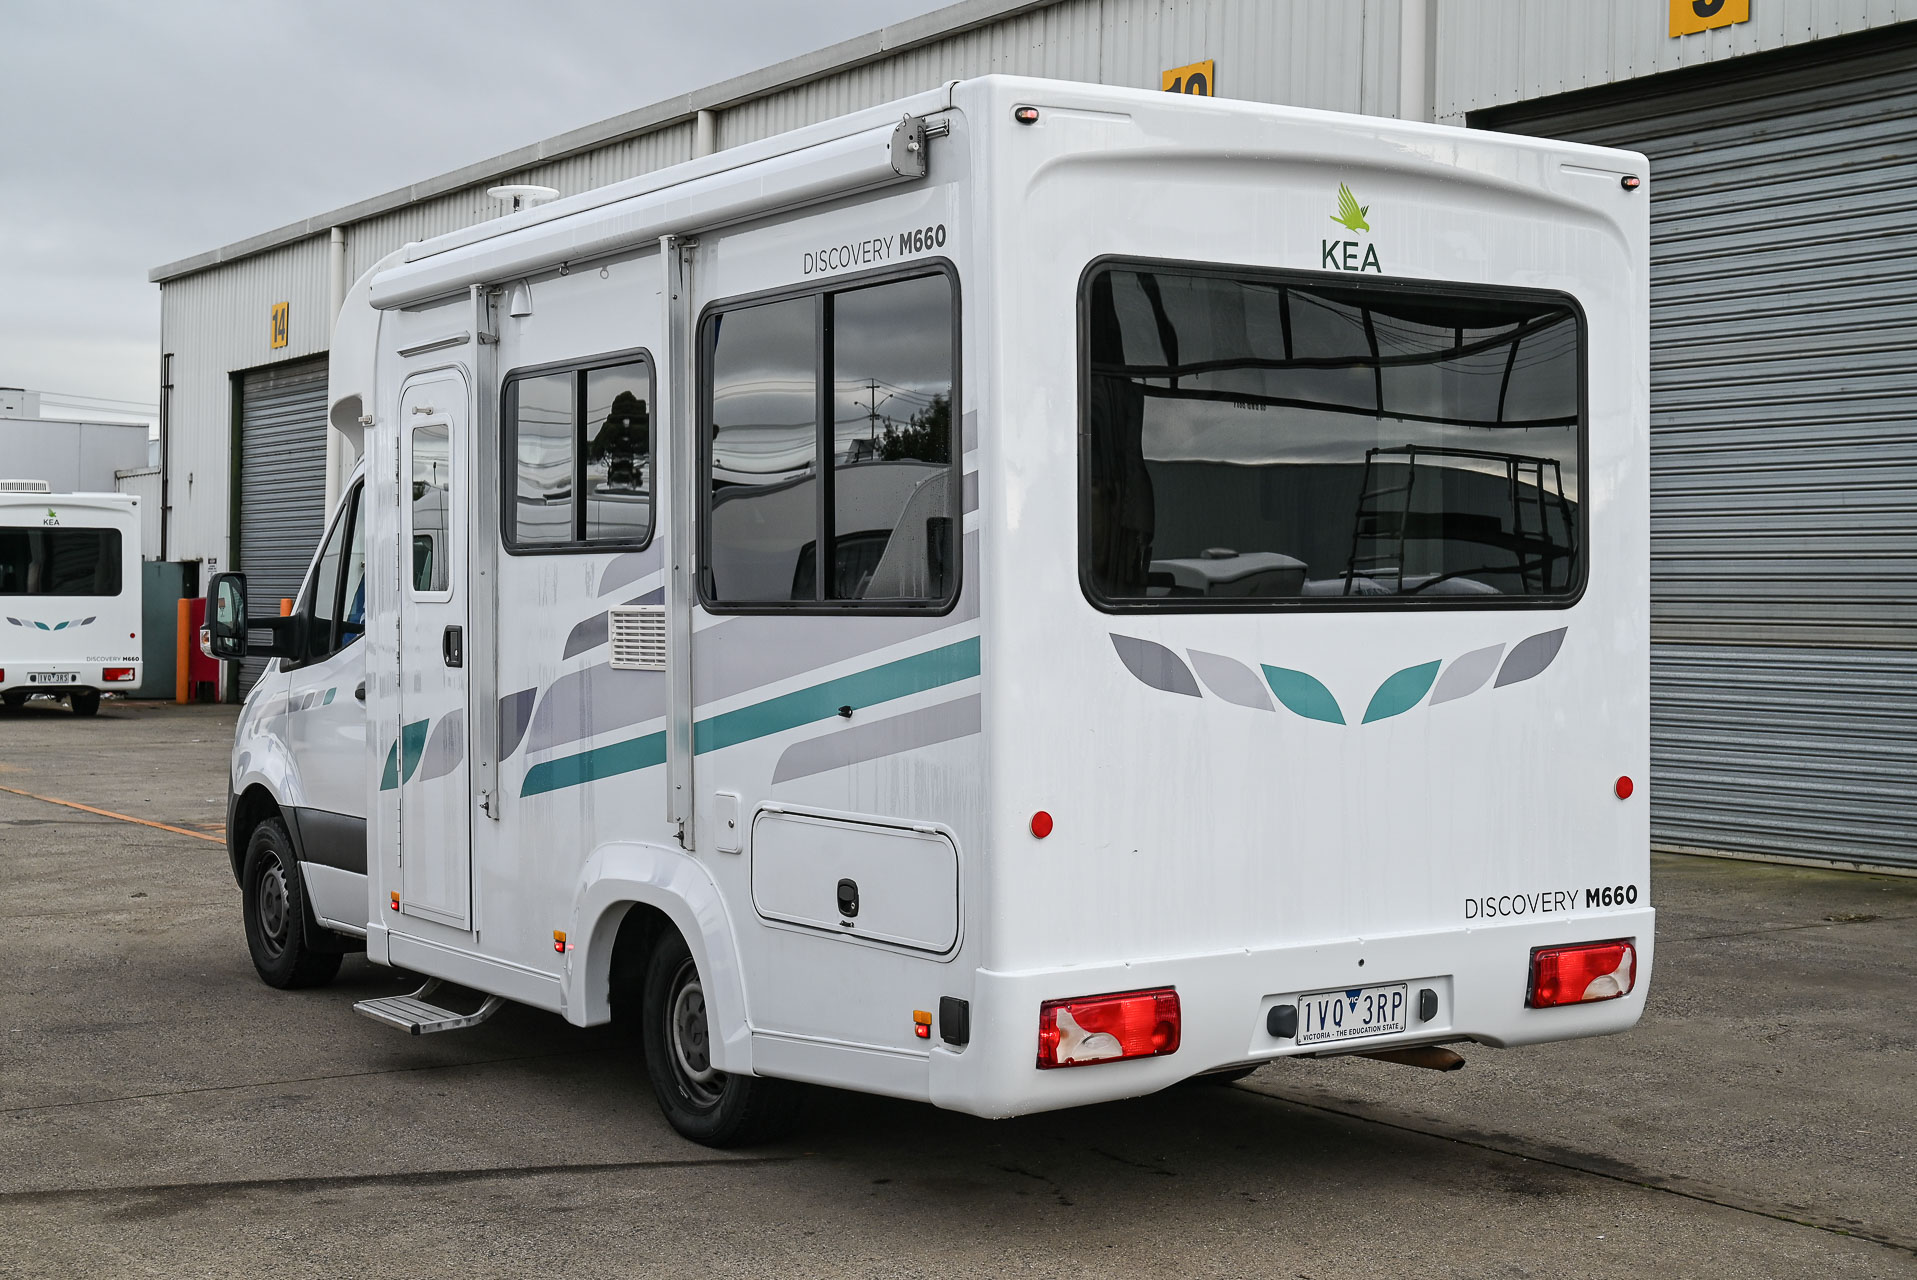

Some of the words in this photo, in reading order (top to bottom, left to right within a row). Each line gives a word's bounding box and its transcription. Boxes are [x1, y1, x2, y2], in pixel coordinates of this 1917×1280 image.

[804, 235, 894, 275] DISCOVERY
[899, 224, 947, 256] M660
[1322, 239, 1382, 273] KEA
[272, 307, 286, 343] 14
[43, 518, 60, 526] KEA
[1465, 889, 1579, 919] DISCOVERY
[1585, 884, 1638, 909] M660
[1305, 998, 1344, 1033] 1VQ
[1362, 991, 1403, 1025] 3RP
[1303, 1031, 1331, 1041] VICTORIA
[1348, 1025, 1382, 1036] EDUCATION
[1382, 1022, 1400, 1031] STATE
